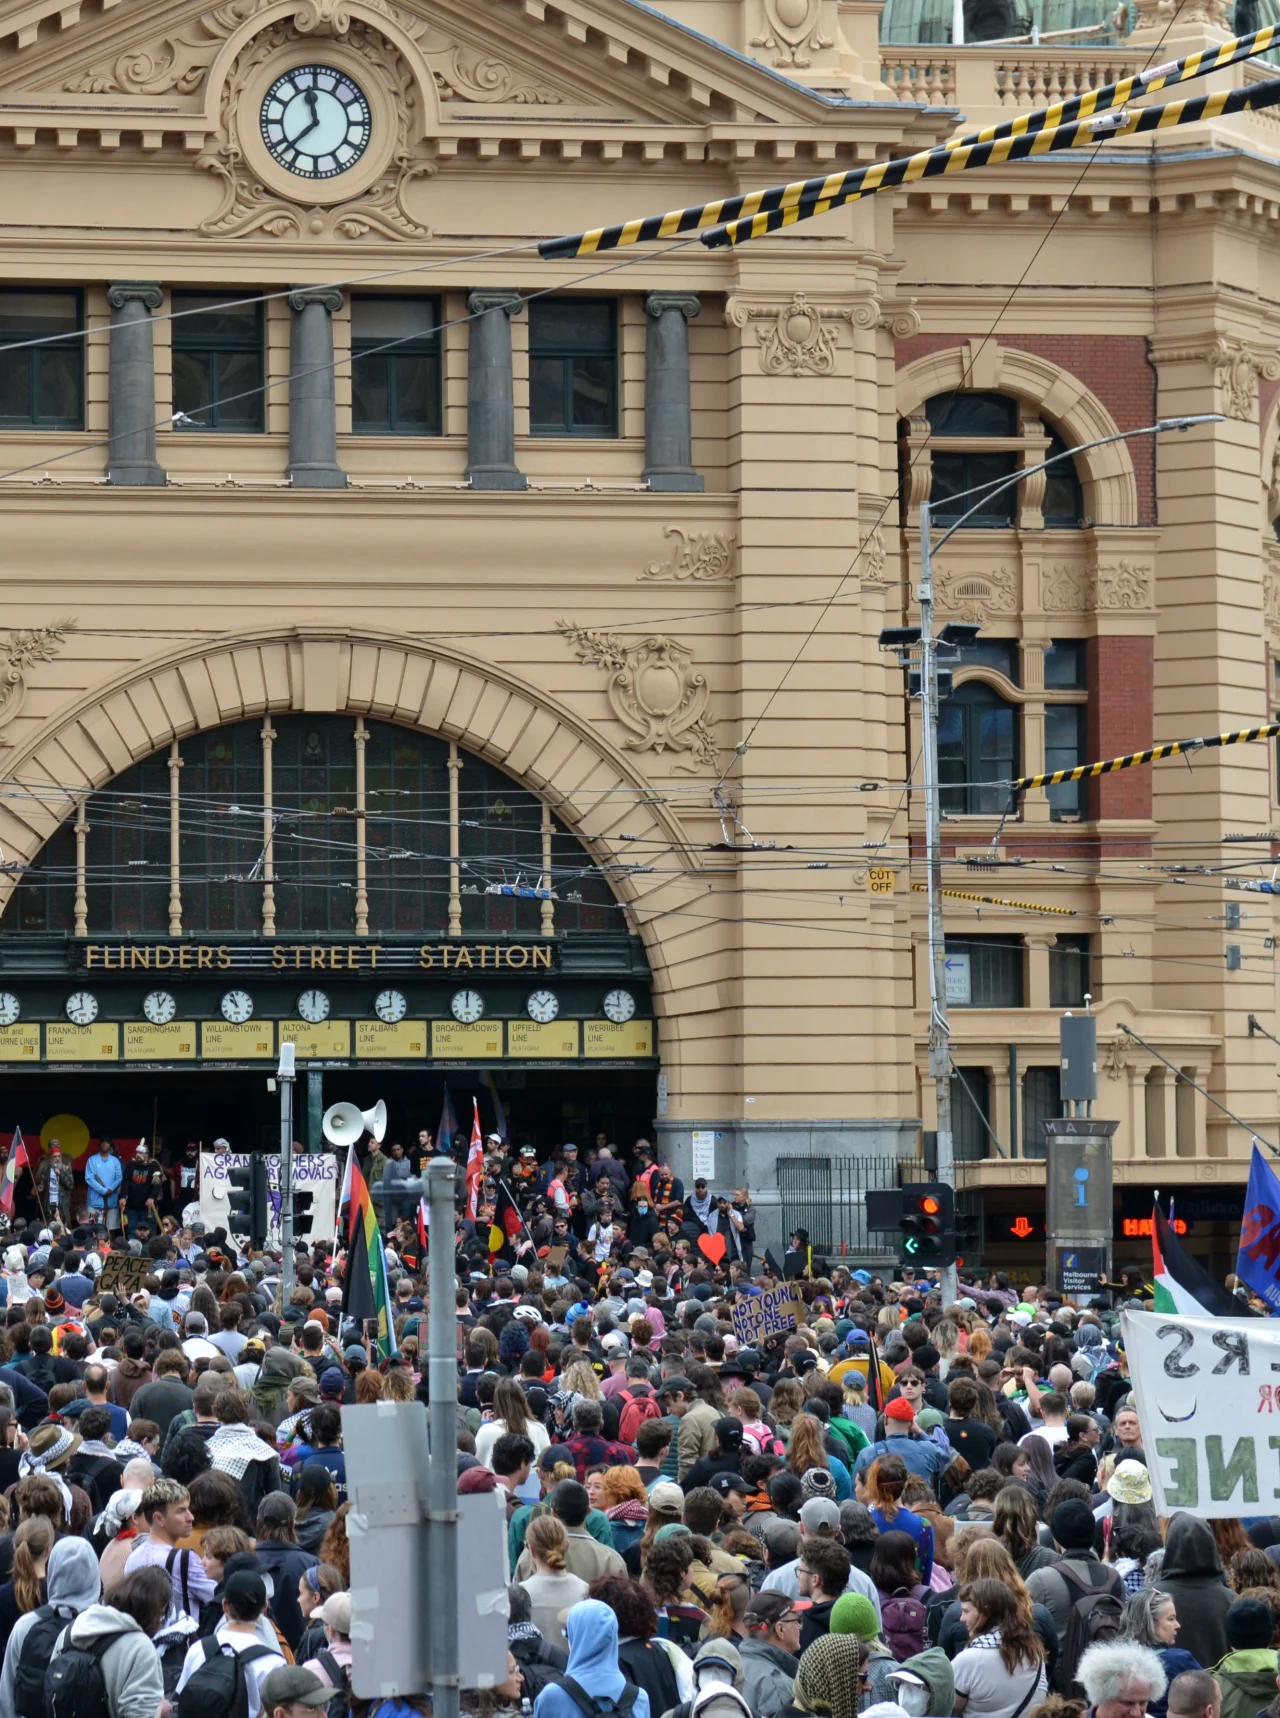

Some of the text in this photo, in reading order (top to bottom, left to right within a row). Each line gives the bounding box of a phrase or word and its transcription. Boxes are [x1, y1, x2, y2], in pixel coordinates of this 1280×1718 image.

[870, 871, 891, 880] CUT
[871, 883, 892, 892] OFF
[85, 945, 553, 969] FLINDERS STREET STATION
[48, 1026, 92, 1034] FRANKSTON
[127, 1026, 181, 1034] SANDRINGHAM
[206, 1024, 262, 1033] WILLIAMSTOWN
[282, 1024, 312, 1032] ALTONA
[20, 1037, 39, 1046] LINES
[48, 1036, 64, 1045] LINE
[127, 1036, 143, 1044] LINE
[206, 1034, 222, 1043] LINE
[282, 1034, 298, 1042] LINE
[359, 1034, 376, 1042] LINE
[436, 1034, 452, 1042] LINE
[214, 1154, 325, 1168] GRANOHERS
[268, 1166, 334, 1180] RMOVALS
[104, 1256, 152, 1274] PEACE
[100, 1274, 140, 1292] GAZA
[733, 1284, 800, 1318] NOT YOUNG
[734, 1306, 780, 1330] NOT ONE
[737, 1312, 795, 1344] NOT FREE
